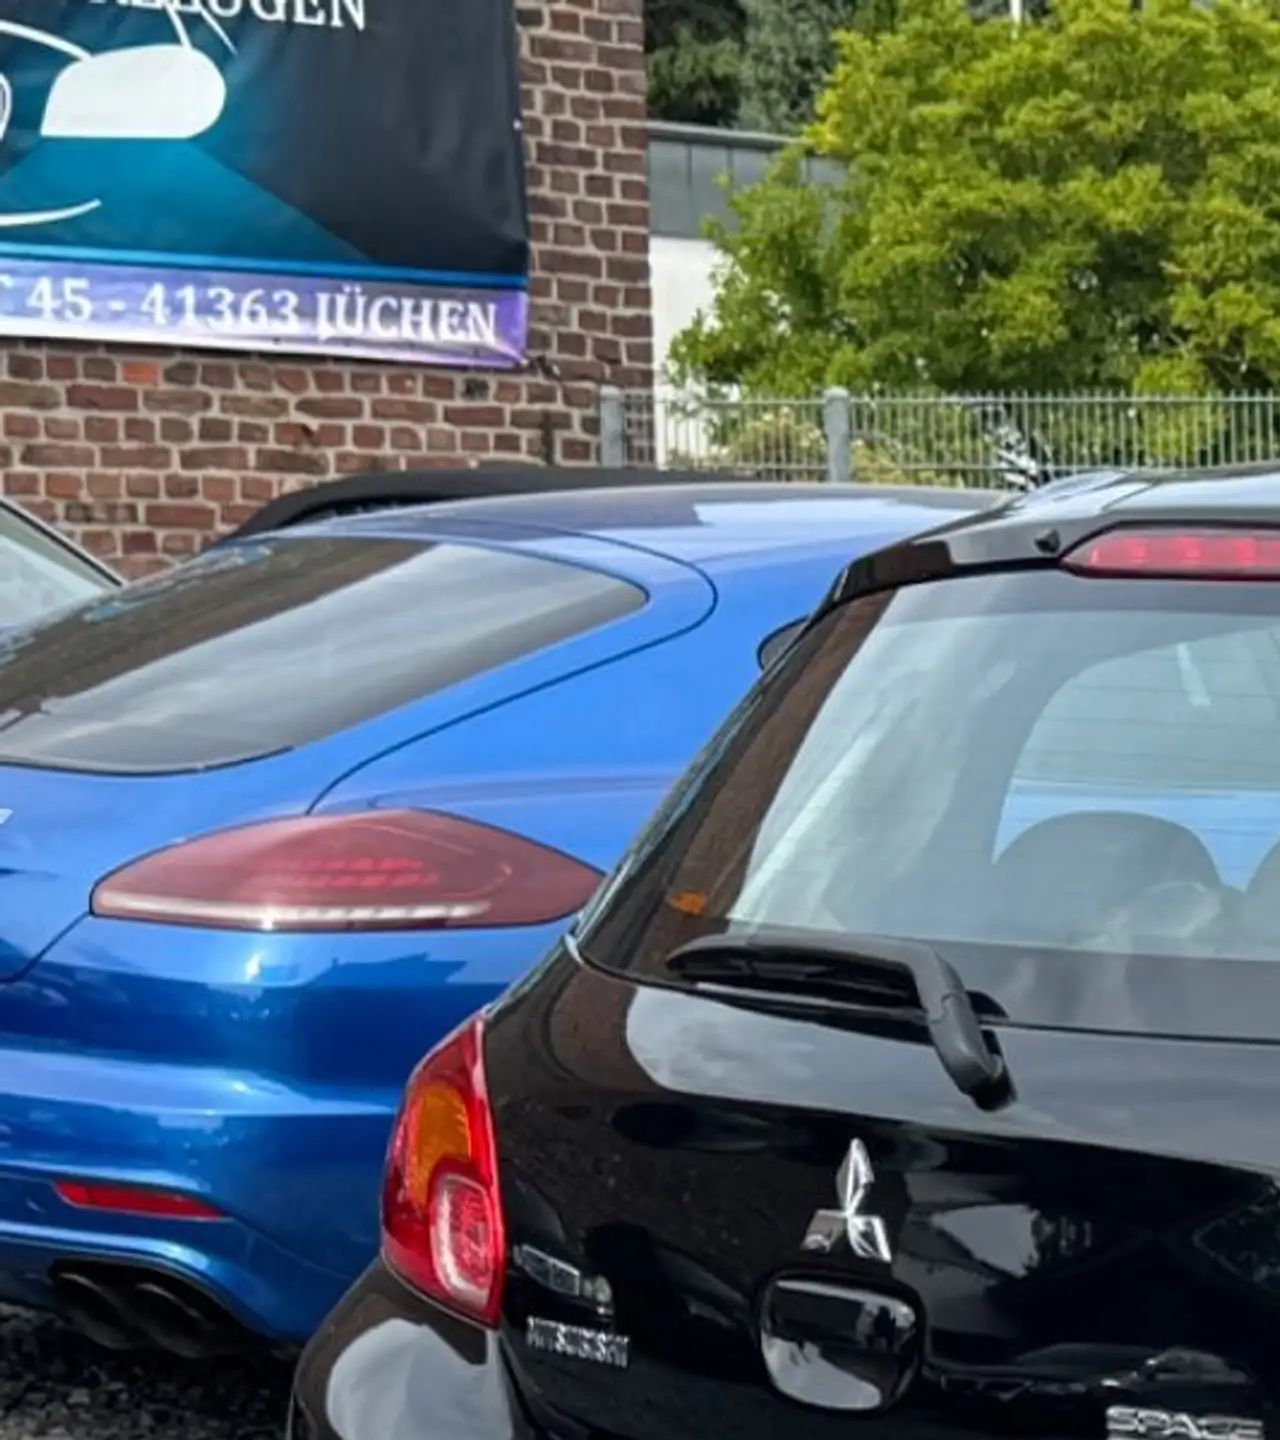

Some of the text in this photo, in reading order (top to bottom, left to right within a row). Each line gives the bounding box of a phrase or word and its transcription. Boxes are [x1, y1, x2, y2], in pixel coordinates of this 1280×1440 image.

[86, 0, 367, 31] UGEN
[26, 276, 93, 322] 45
[140, 281, 300, 331] 41363
[315, 284, 498, 344] JÜCHEN
